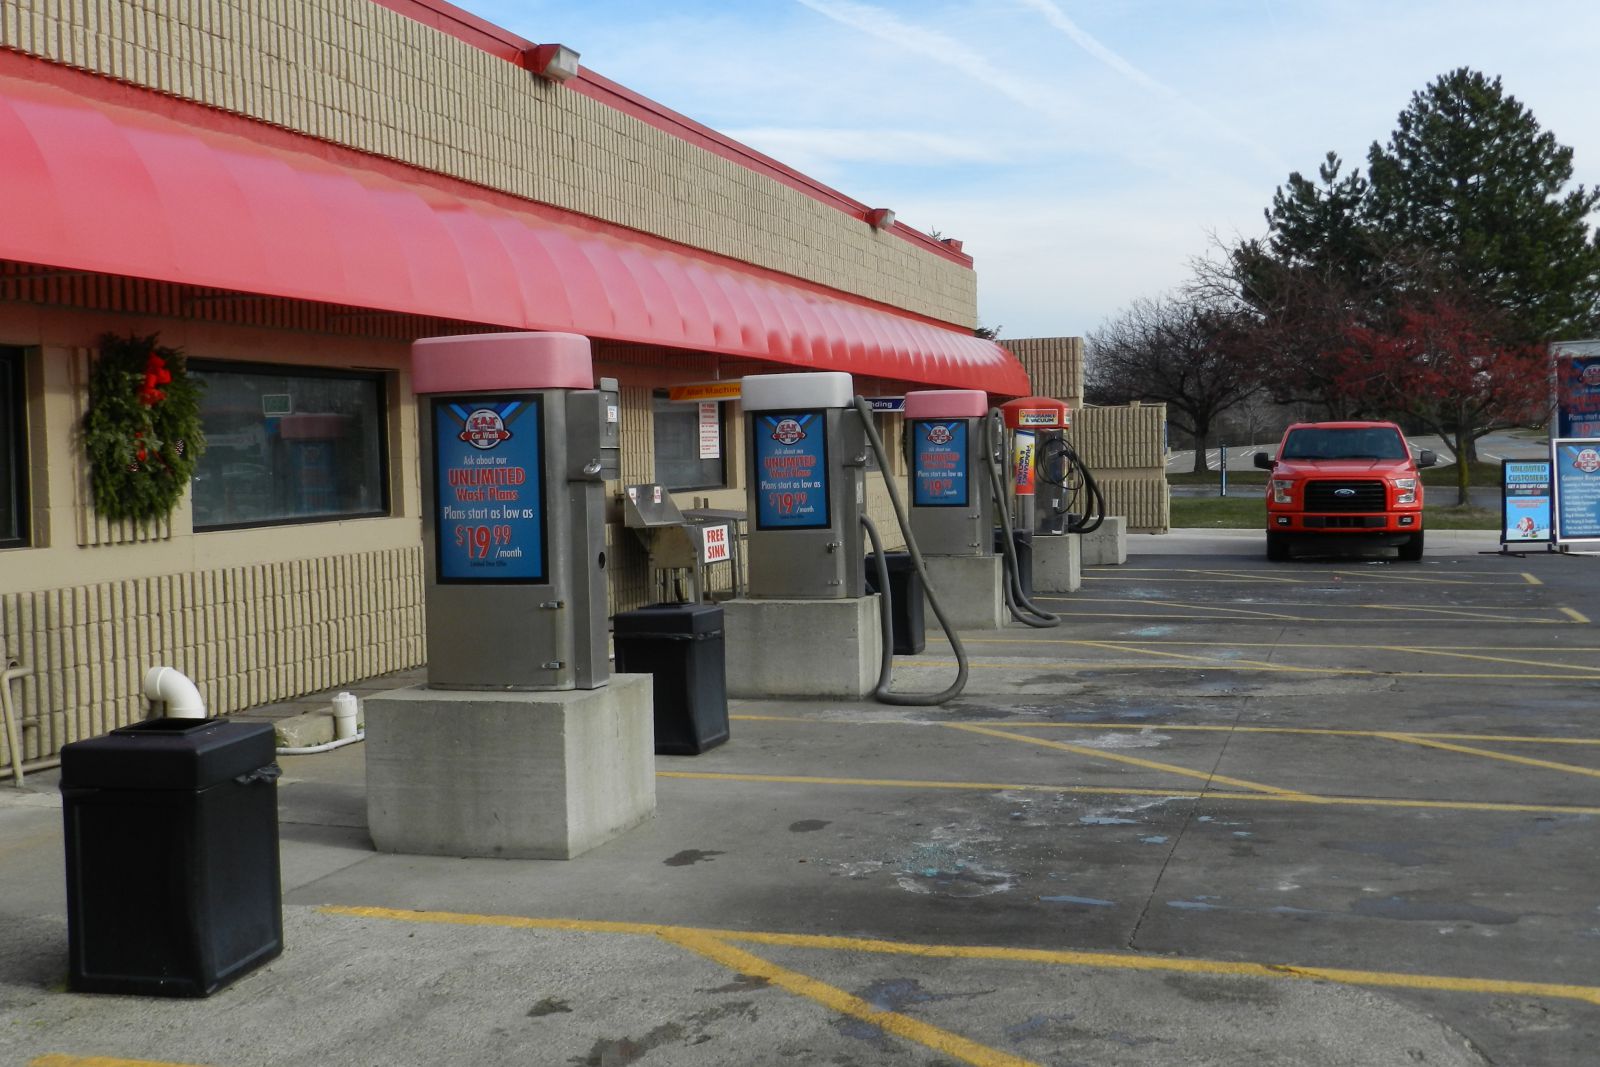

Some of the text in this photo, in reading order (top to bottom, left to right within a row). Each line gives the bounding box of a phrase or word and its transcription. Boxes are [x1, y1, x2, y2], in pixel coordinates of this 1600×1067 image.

[482, 431, 499, 439] Wash
[463, 454, 507, 465] Ask about our
[764, 455, 816, 468] UNLIMITED
[1510, 464, 1547, 473] UNLIMITED
[448, 466, 526, 487] UNLIMITED
[1508, 474, 1548, 482] CUSTOMERS
[761, 480, 777, 489] Plans
[801, 479, 813, 488] low
[455, 487, 519, 502] Wash Plans
[444, 505, 534, 520] Plans start as low as
[706, 529, 724, 543] FREE
[495, 546, 522, 559] /month
[707, 544, 726, 559] SINK
